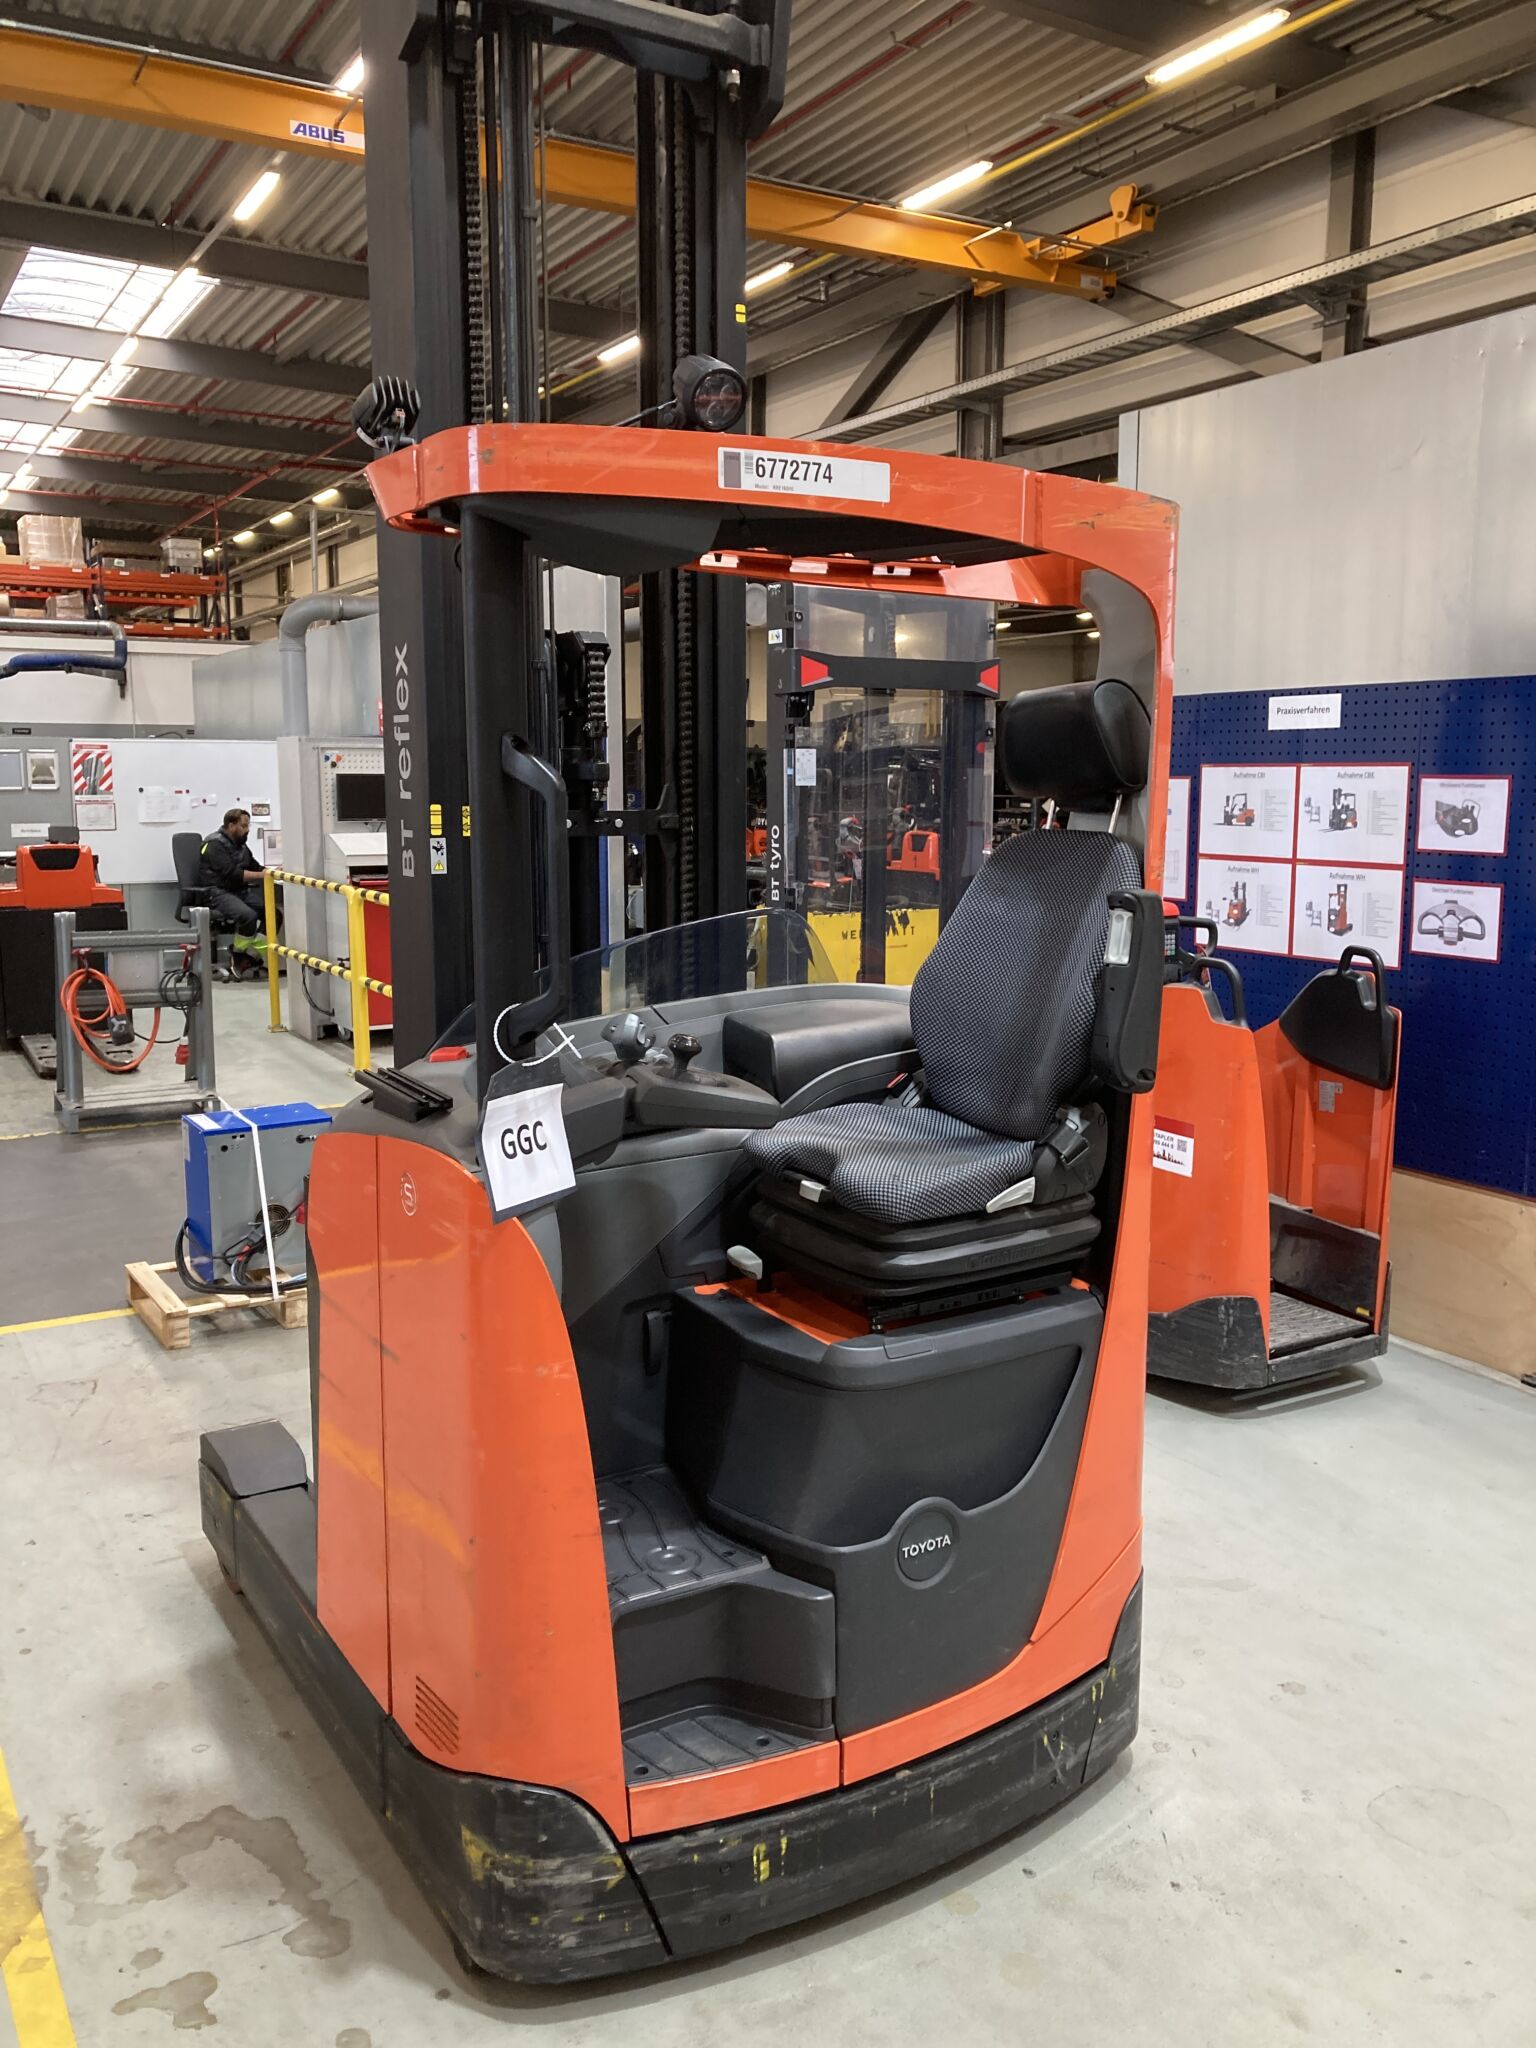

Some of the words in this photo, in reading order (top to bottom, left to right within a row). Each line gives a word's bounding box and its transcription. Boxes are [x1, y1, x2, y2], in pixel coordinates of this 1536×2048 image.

[293, 122, 345, 144] ABUS
[755, 456, 833, 484] 6772774
[393, 642, 412, 800] reflex
[1276, 705, 1331, 716] Praxisverfahren
[401, 819, 415, 878] BT
[769, 825, 782, 870] tyro
[771, 878, 780, 901] BT
[500, 1120, 548, 1160] GGC
[901, 1534, 951, 1559] TOYOTA
